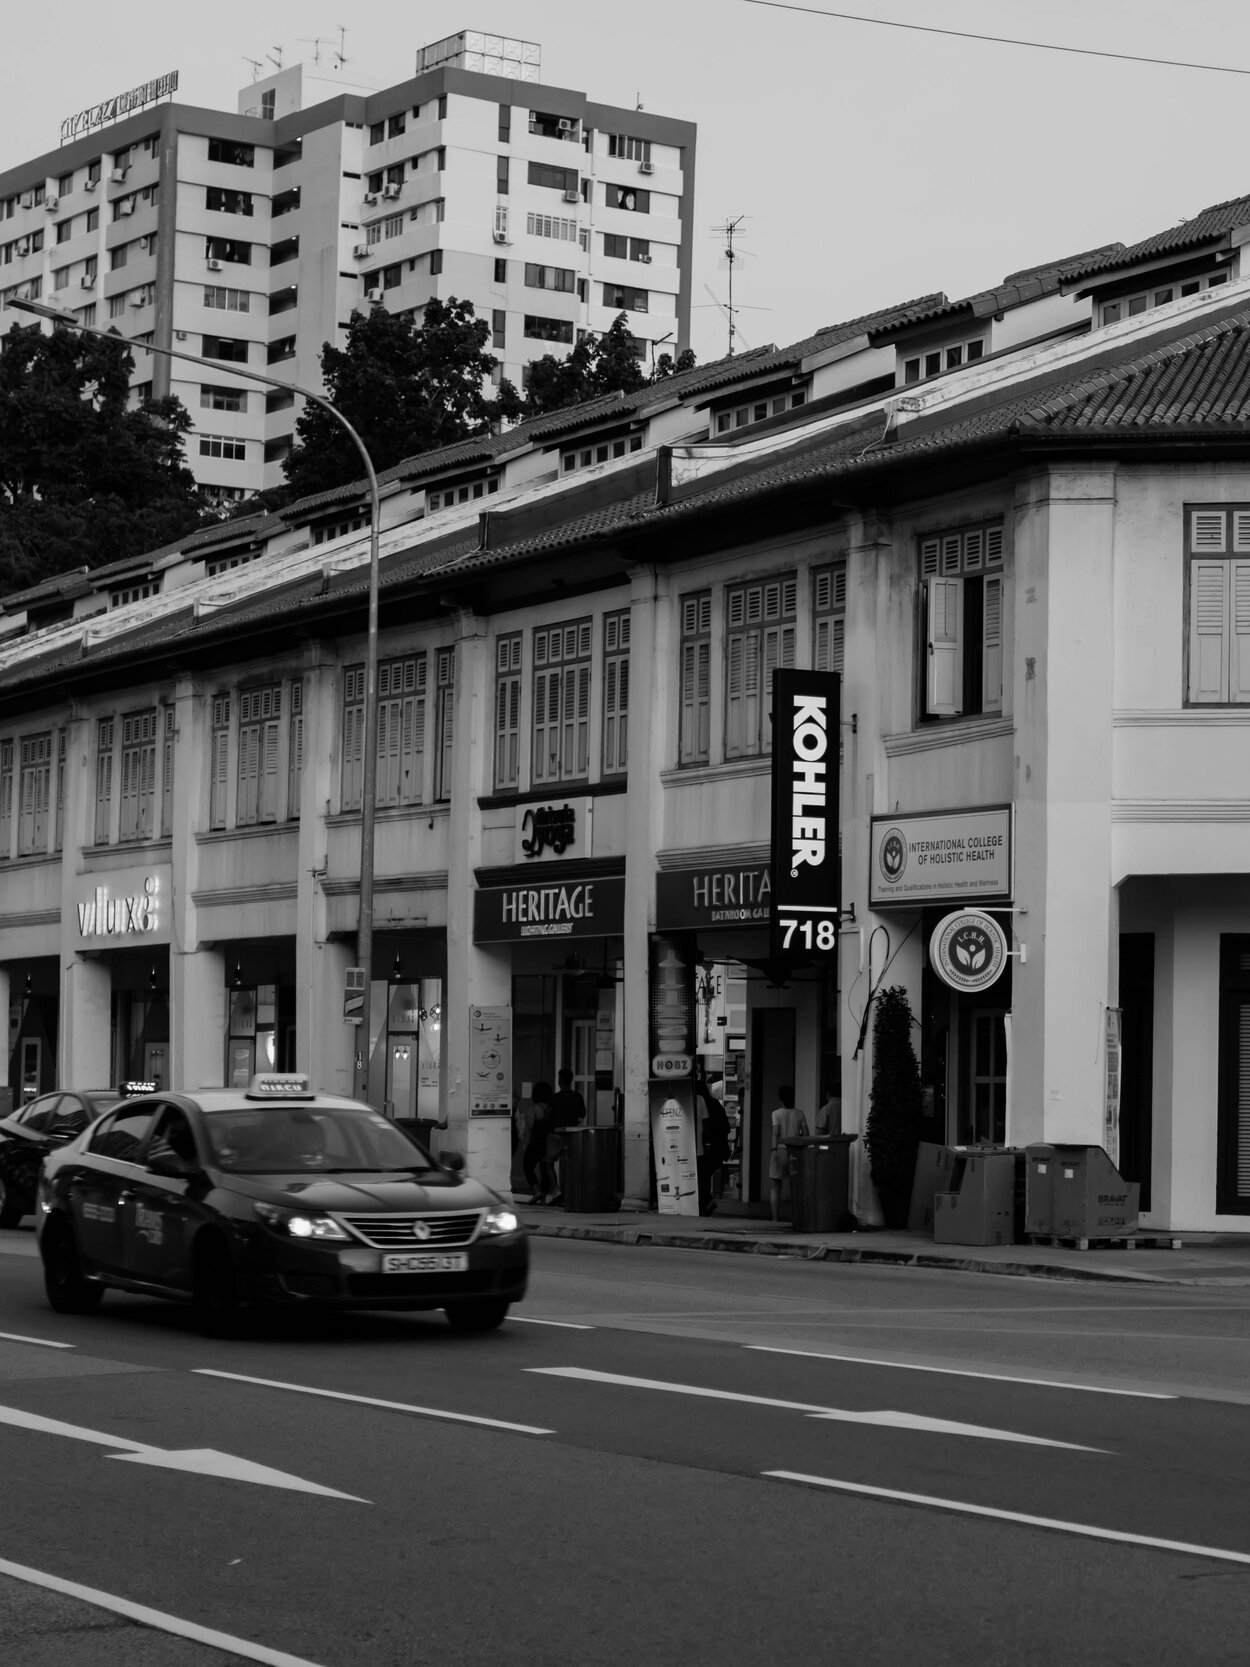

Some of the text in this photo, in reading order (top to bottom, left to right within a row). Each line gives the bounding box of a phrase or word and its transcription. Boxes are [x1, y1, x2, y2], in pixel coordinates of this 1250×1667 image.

[792, 695, 828, 869] KOHLER
[908, 839, 966, 854] INTERNATIONAL
[967, 835, 1003, 849] COLLEGE
[917, 849, 995, 866] OF HOLISTIC HEALTH
[693, 869, 771, 908] HERITA
[502, 885, 594, 923] HERITAGE
[779, 919, 836, 950] 718
[657, 1060, 688, 1070] HOBZ
[1098, 1195, 1129, 1203] BRAVAT
